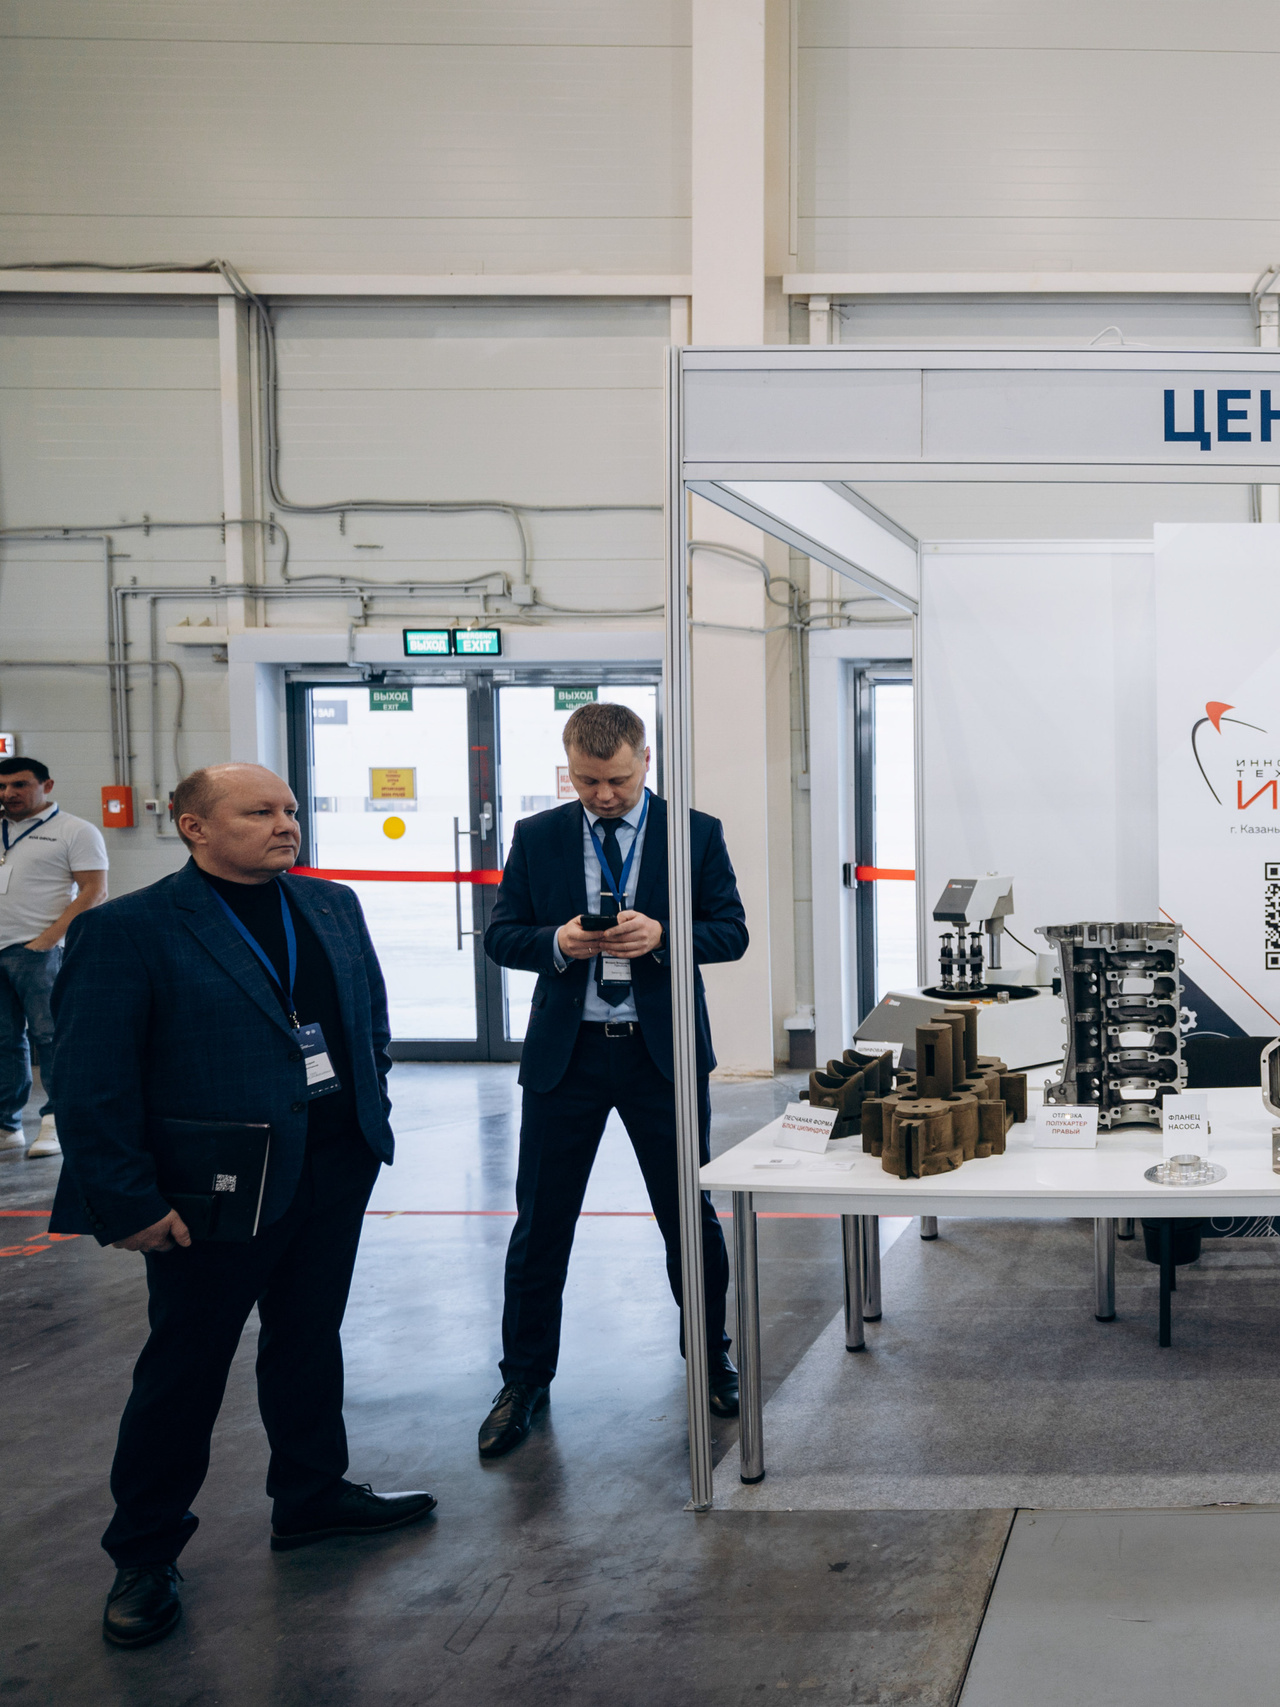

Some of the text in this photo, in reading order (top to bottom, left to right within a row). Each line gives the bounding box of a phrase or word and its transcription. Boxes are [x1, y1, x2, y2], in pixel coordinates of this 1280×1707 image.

[410, 640, 447, 652] ВЫХОД
[462, 640, 492, 652] EXIT
[373, 692, 409, 702] ВЫХОД
[558, 691, 594, 701] ВЫХОД
[382, 703, 399, 711] EXIT
[784, 1114, 833, 1127] ПЕСЧАНАЯ ФОРМА
[781, 1122, 830, 1136] БЛОК ЦИЛИНДРОВ
